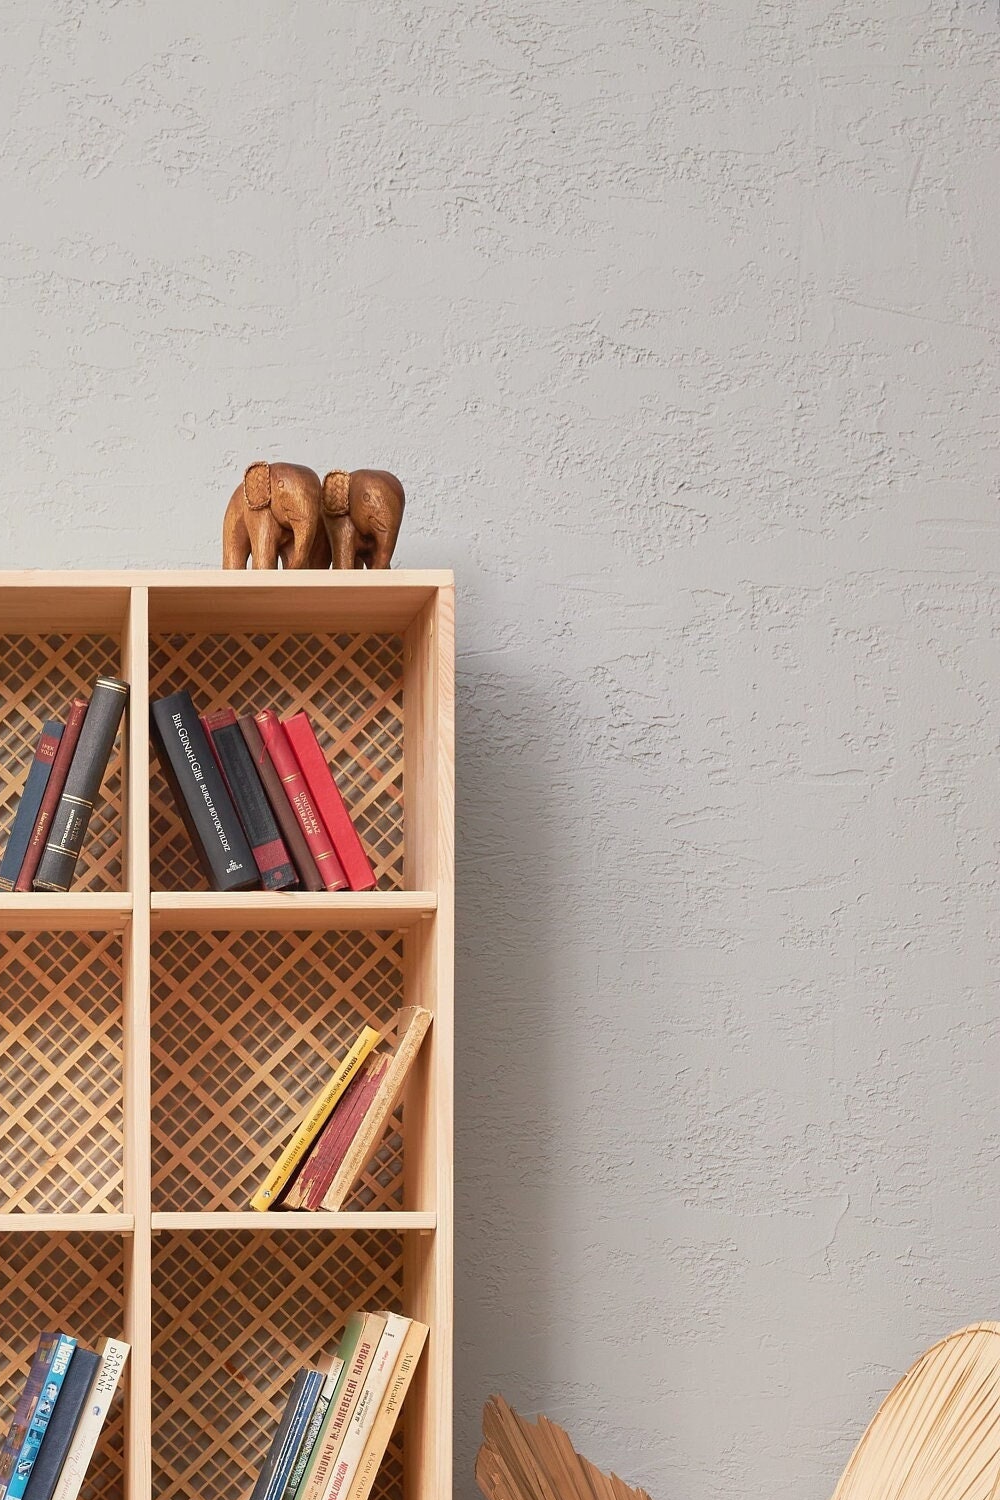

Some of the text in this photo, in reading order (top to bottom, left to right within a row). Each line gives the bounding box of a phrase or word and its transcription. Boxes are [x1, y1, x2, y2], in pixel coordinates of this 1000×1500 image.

[199, 783, 214, 807] BURCU
[299, 792, 320, 834] UNUTULMAZ
[96, 1347, 117, 1393] DUNANT
[105, 1353, 123, 1391] SARAH
[353, 1342, 371, 1375] RAPORU
